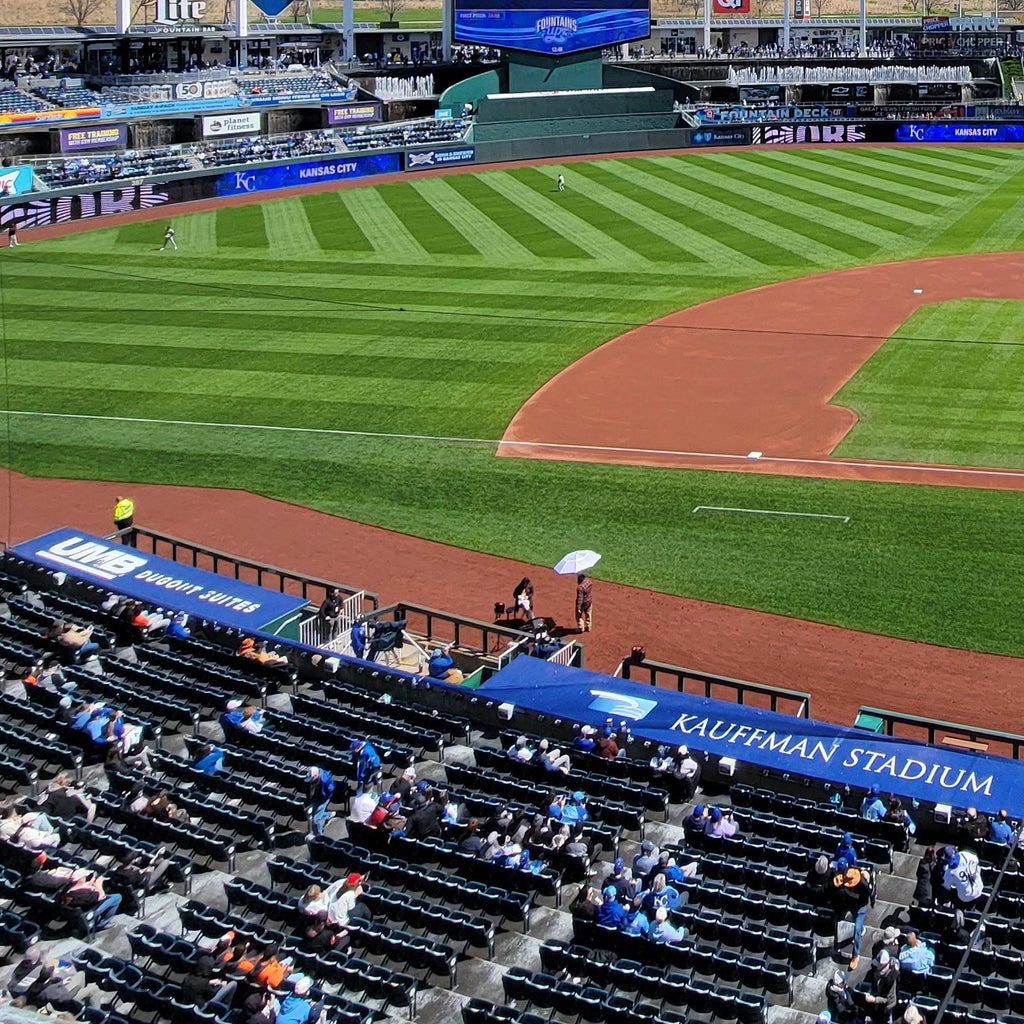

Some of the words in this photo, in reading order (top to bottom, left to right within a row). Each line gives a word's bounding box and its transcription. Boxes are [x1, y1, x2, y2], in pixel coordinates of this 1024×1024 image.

[536, 16, 577, 33] FOUNTAINS
[224, 117, 250, 126] planet
[720, 108, 790, 121] FOUNTAIN
[794, 108, 830, 118] DECK
[68, 132, 87, 140] FREE
[910, 125, 924, 140] KC
[955, 128, 982, 136] KANSAS
[983, 128, 998, 136] CITY
[300, 166, 336, 178] KANSAS
[336, 162, 358, 173] CITY
[235, 172, 256, 192] KC
[49, 536, 148, 575] UMB
[134, 570, 204, 595] DUGOUT
[198, 590, 262, 614] SUITES
[670, 713, 841, 763] KAUFFMAN
[842, 748, 995, 796] STADIUM
